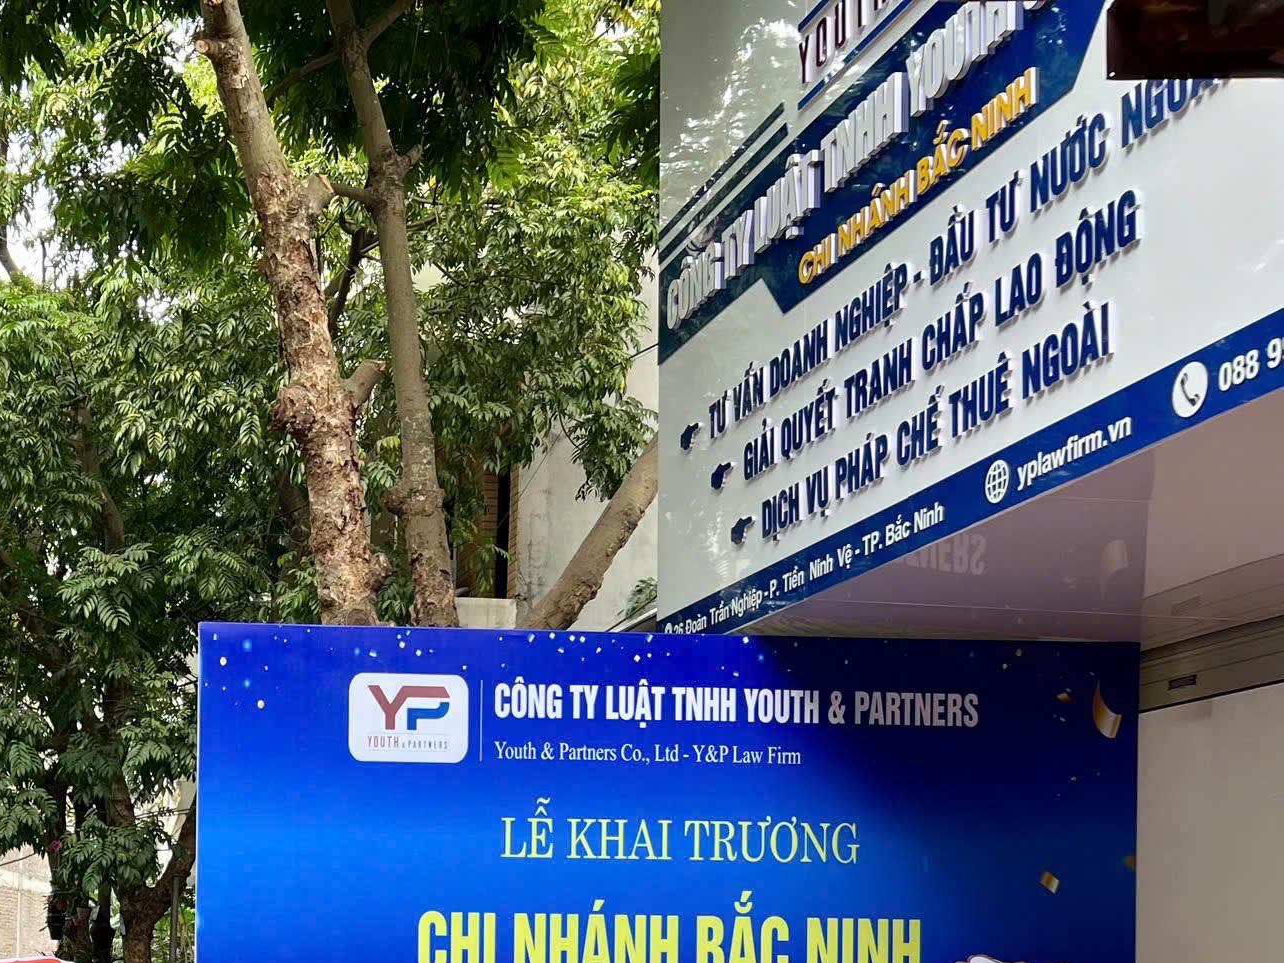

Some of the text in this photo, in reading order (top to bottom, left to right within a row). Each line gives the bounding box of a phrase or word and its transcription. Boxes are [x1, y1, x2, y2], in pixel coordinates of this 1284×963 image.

[798, 67, 1039, 285] CHI NHÁNH BẮC NINH
[721, 210, 755, 280] TY
[754, 150, 823, 254] LUẬT
[709, 389, 733, 440] TƯ
[733, 361, 767, 422] VẤN
[769, 318, 832, 399] DOANH
[834, 262, 911, 352] NGHIỆP
[929, 205, 978, 286] ĐẦU
[986, 171, 1024, 243] TƯ
[1030, 112, 1111, 213] NƯỚC
[744, 190, 1141, 481] GIẢI QUYẾT TRANH CHẤP LAO ĐỘNG
[1218, 337, 1284, 392] 088 9
[762, 301, 1113, 542] DỊCH VỤ PHÁP CHẾ THUÊ NGOÀI
[1017, 417, 1132, 491] yplawfirm.vn
[685, 613, 707, 634] Đoàn
[731, 588, 763, 618] Nghiệp
[783, 564, 805, 593] Tiền
[809, 556, 833, 581] Ninh
[836, 544, 853, 570] Vệ
[861, 532, 883, 557] TP.
[886, 515, 911, 545] Bắc
[913, 502, 945, 534] Ninh
[367, 685, 451, 731] YP
[494, 676, 980, 728] CÔNG TY LUẬT TNHH YOUTH & PARTNERS
[367, 736, 400, 750] YOUTH
[494, 741, 537, 761] Youth
[541, 742, 555, 761] &
[558, 743, 617, 762] Partners
[620, 744, 651, 764] Co.,
[654, 744, 679, 762] Ltd
[692, 745, 729, 763] Y&P
[732, 746, 764, 764] Law
[767, 746, 801, 765] Firm
[500, 797, 860, 864] LỄ KHAI TRƯƠNG
